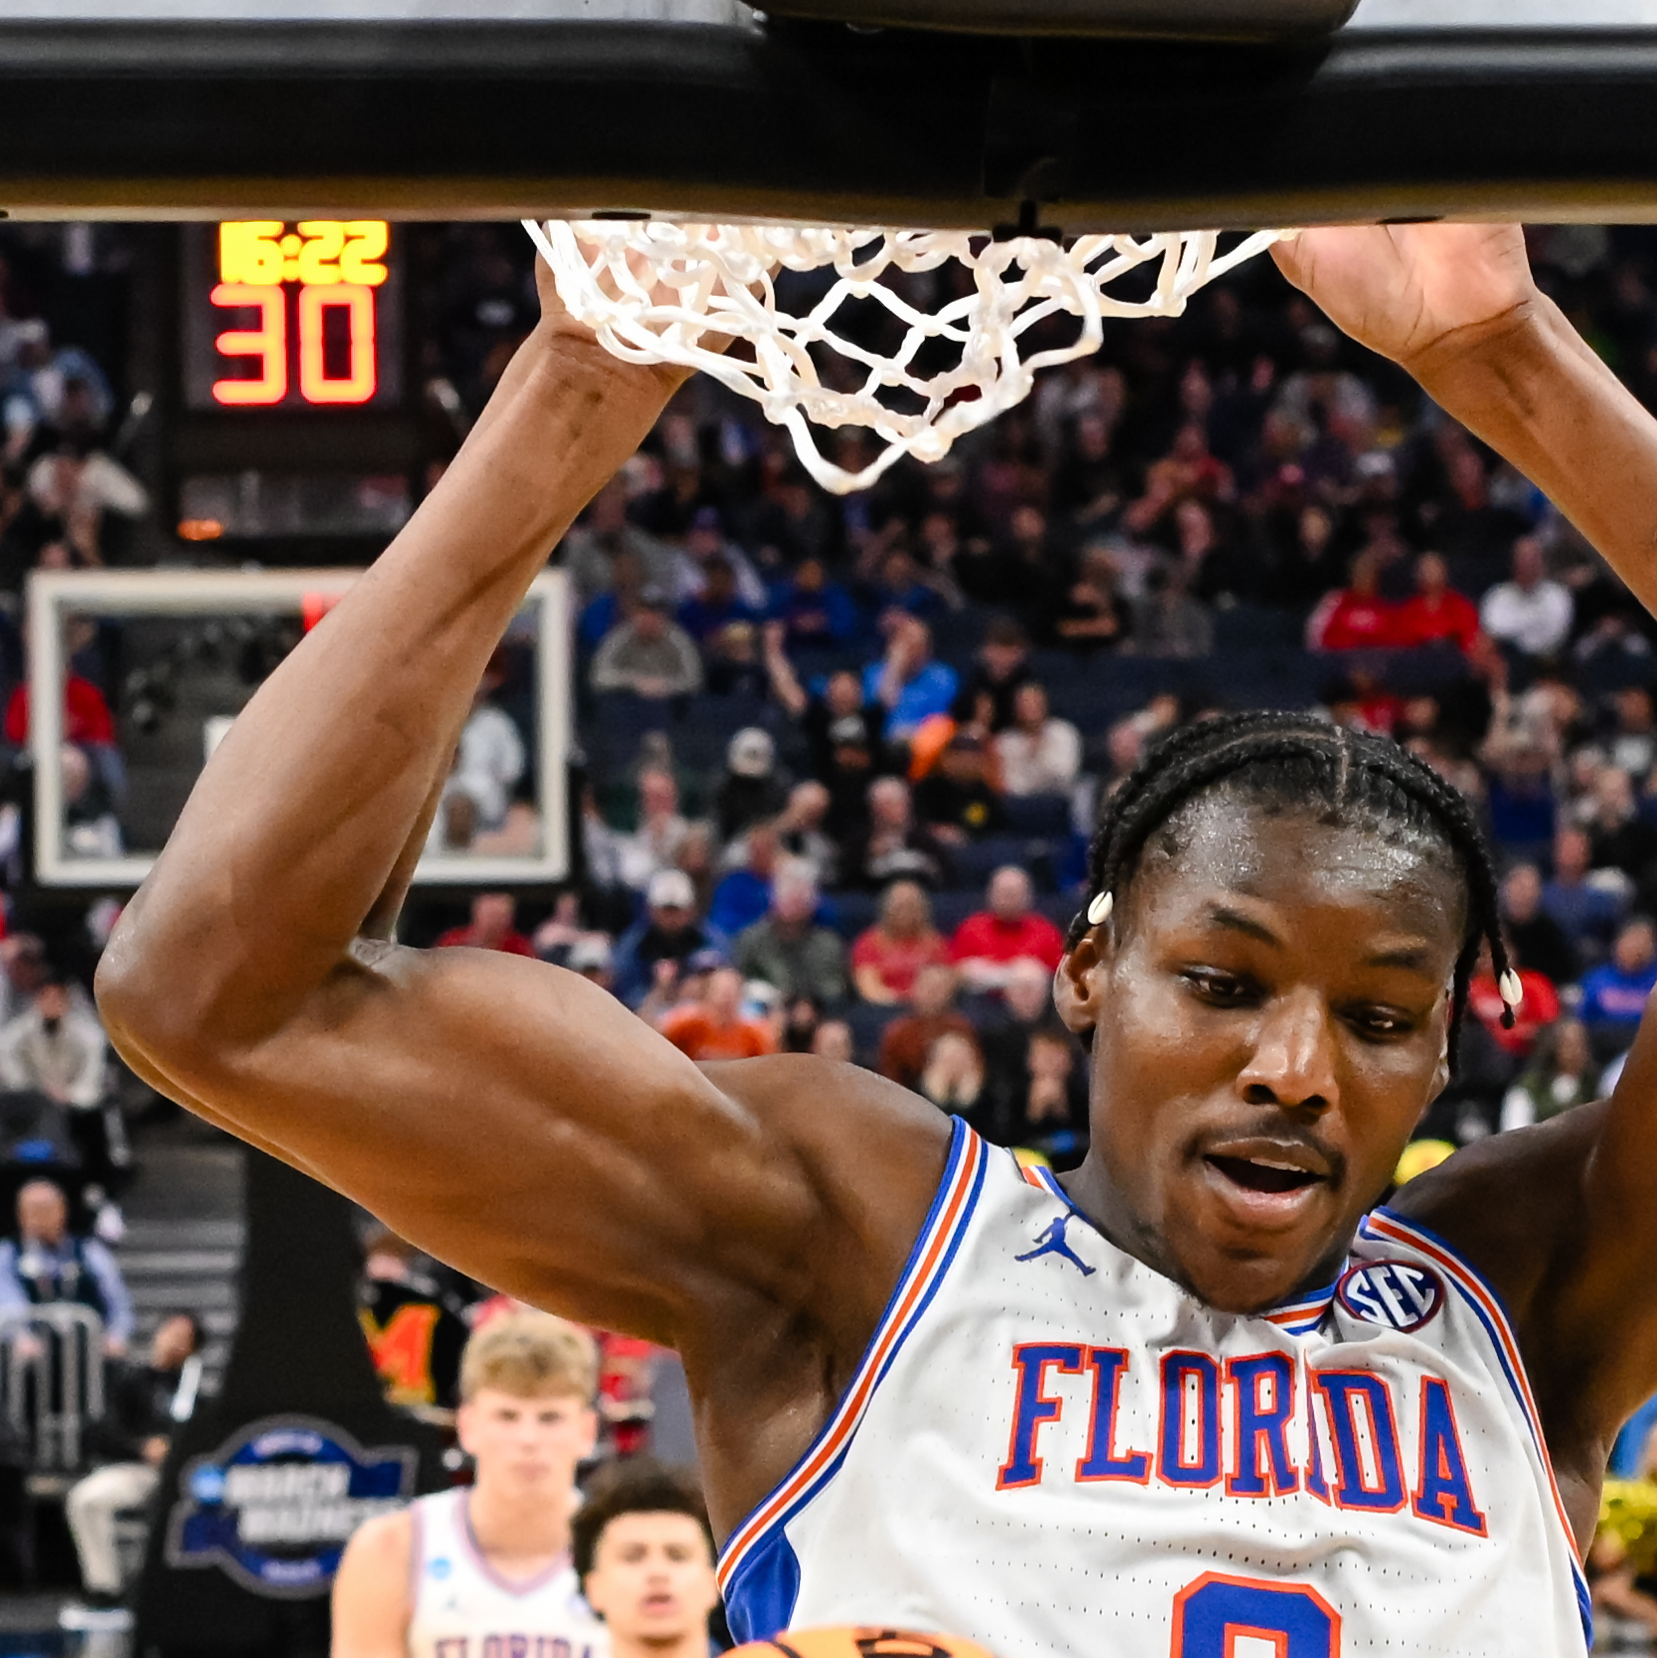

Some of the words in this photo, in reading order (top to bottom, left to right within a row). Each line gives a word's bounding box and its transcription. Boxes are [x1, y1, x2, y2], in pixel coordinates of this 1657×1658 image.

[210, 283, 376, 404] 30
[1346, 1264, 1435, 1328] SEC
[995, 1342, 1489, 1538] FLORIDA
